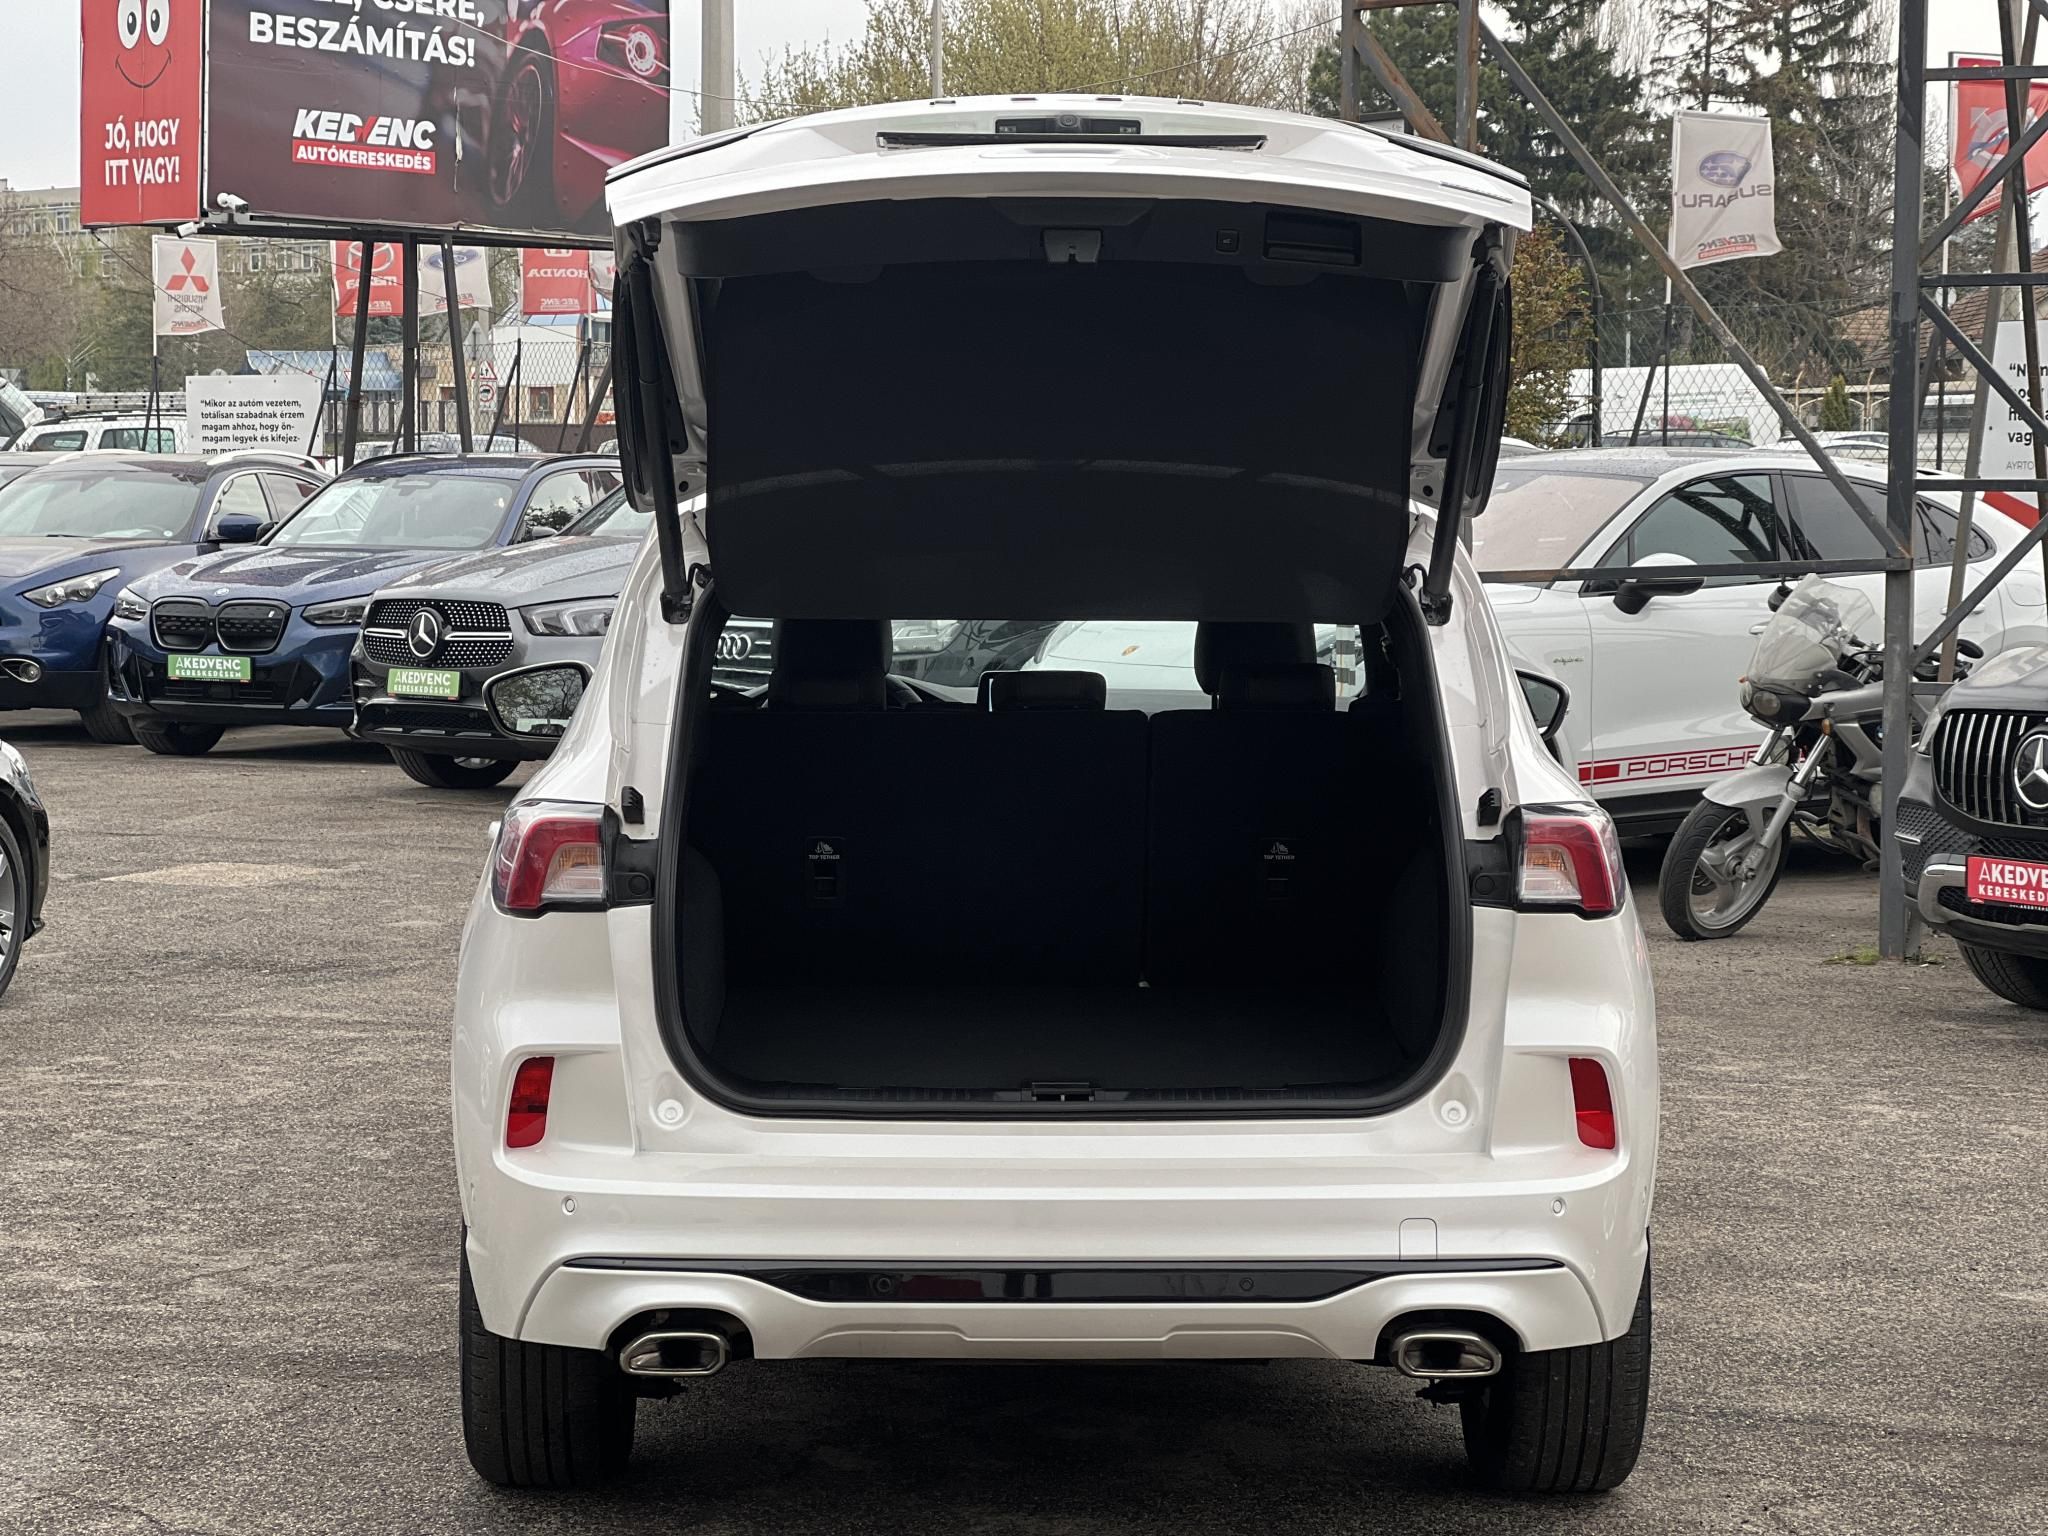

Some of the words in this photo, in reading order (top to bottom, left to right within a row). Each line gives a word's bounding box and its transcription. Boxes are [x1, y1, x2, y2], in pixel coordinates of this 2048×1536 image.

[249, 11, 476, 68] BESZÁMÍTÁS!
[104, 114, 131, 154] JÓ,
[134, 118, 180, 148] HOGY
[292, 108, 437, 150] KEDVENC
[296, 145, 432, 171] AUTÓKERESKEDÉS
[105, 158, 129, 186] ITT
[132, 155, 180, 185] VAGY!
[200, 411, 234, 419] totálisan
[235, 411, 278, 419] szabadnak
[279, 411, 305, 419] érzem
[238, 399, 264, 407] autóm
[266, 399, 302, 409] vezetem,
[201, 424, 231, 433] magam
[231, 422, 258, 432] ahhoz,
[259, 422, 280, 433] hogy
[201, 435, 231, 445] magam
[232, 433, 259, 445] legyek
[259, 434, 270, 443] és
[1978, 884, 2048, 903] KERESKED
